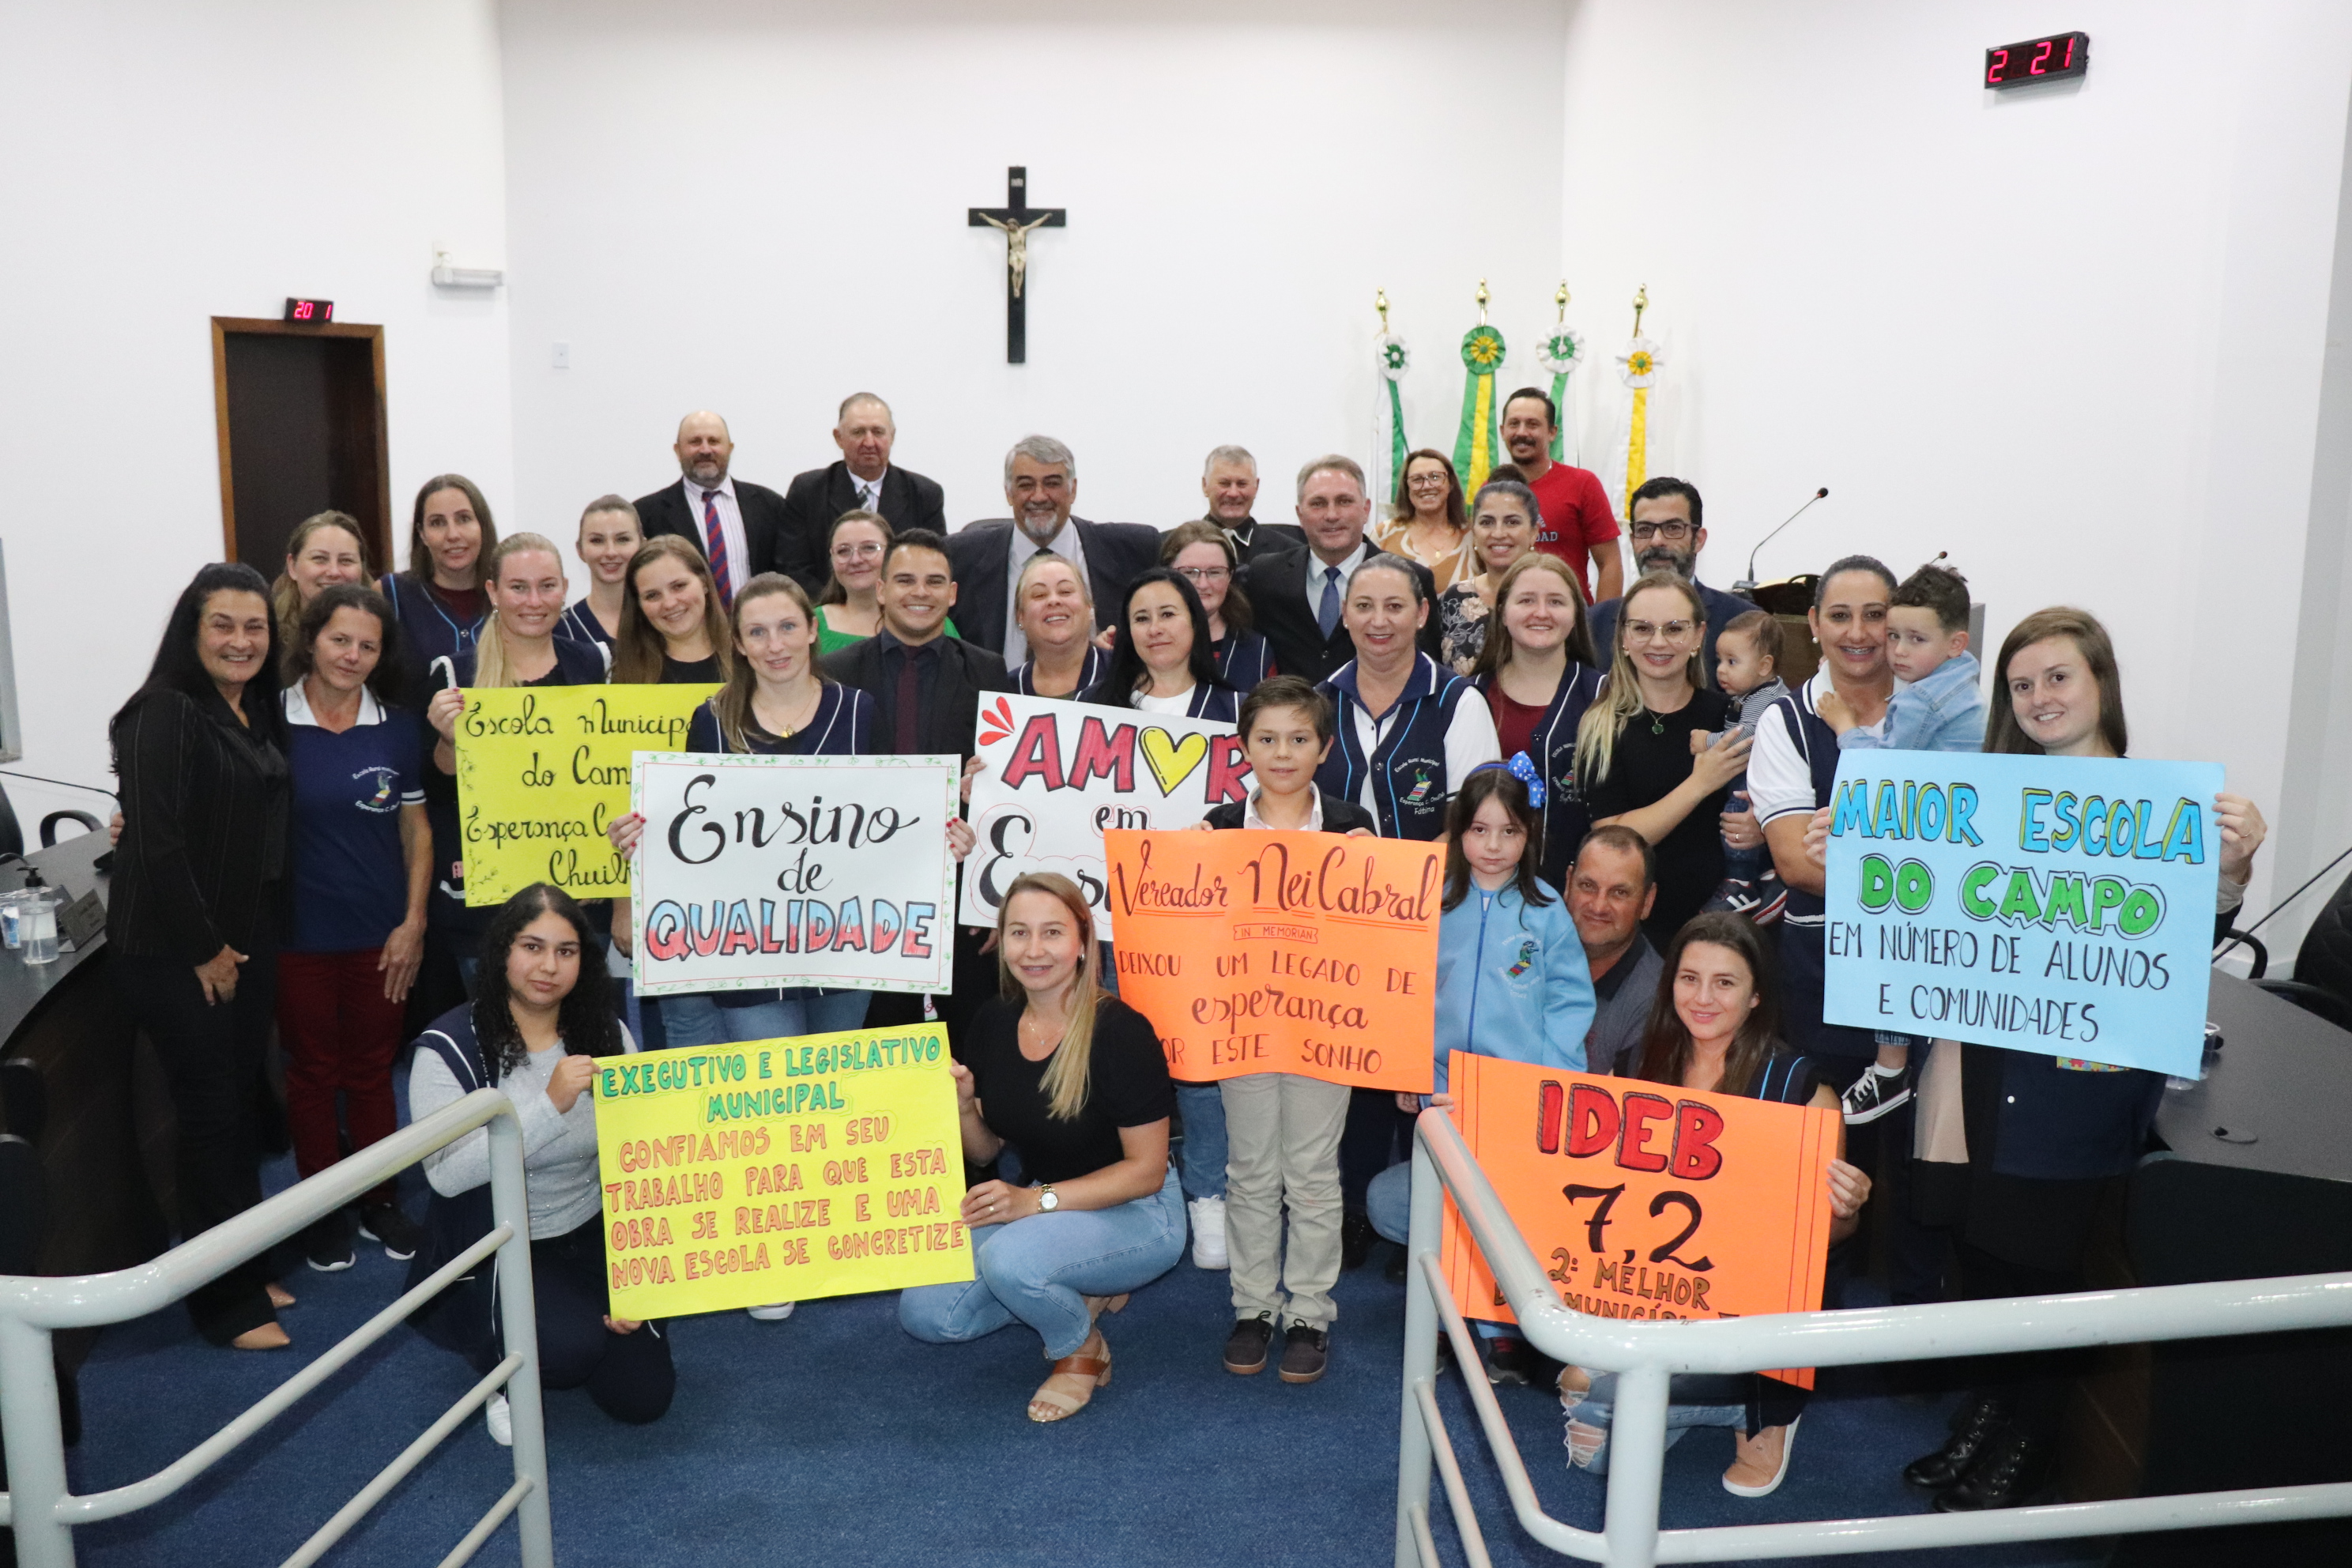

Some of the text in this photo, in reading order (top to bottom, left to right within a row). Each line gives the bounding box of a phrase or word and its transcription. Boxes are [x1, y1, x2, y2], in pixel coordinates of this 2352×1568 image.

[2030, 38, 2074, 74] 21
[293, 301, 314, 319] 20
[466, 694, 693, 747] Escola Municip
[522, 744, 631, 786] do Cam
[466, 805, 589, 850] Esperança
[668, 774, 920, 865] Ensino
[1095, 806, 1148, 832] em
[1829, 779, 2205, 864] MAIOR ESCOLA
[777, 847, 834, 895] de
[1112, 839, 1438, 922] Vereador Nei Cabral
[1858, 854, 2165, 938] DO CAMPO
[646, 895, 937, 961] QUALIDADE
[1242, 925, 1313, 940] IN MEMORIAN
[1829, 922, 2170, 990] EM NÚMERO DE ALUNOS
[1119, 950, 1417, 996] DEIXOU UM LEGADO DE
[1191, 983, 1368, 1035] esperança
[1878, 983, 2099, 1043] E COMUNIDADES
[601, 1035, 941, 1098] EXECUTIVO E LEGISLATIVO
[1160, 1033, 1382, 1075] OR ESTE SONHO
[706, 1081, 846, 1123] MUNICIPAL
[1536, 1080, 1724, 1181] IDEB
[619, 1116, 890, 1174] CONFIAMOS EM SEU
[605, 1148, 946, 1213] TRABALHO PARA QUE ESTA
[610, 1186, 941, 1252] OBRA SE REALIZE E UMA
[1562, 1183, 1716, 1272] 7,2
[611, 1220, 965, 1290] NOVA ESCOLA SE CONCRETIZE
[1593, 1257, 1711, 1311] MELHOR
